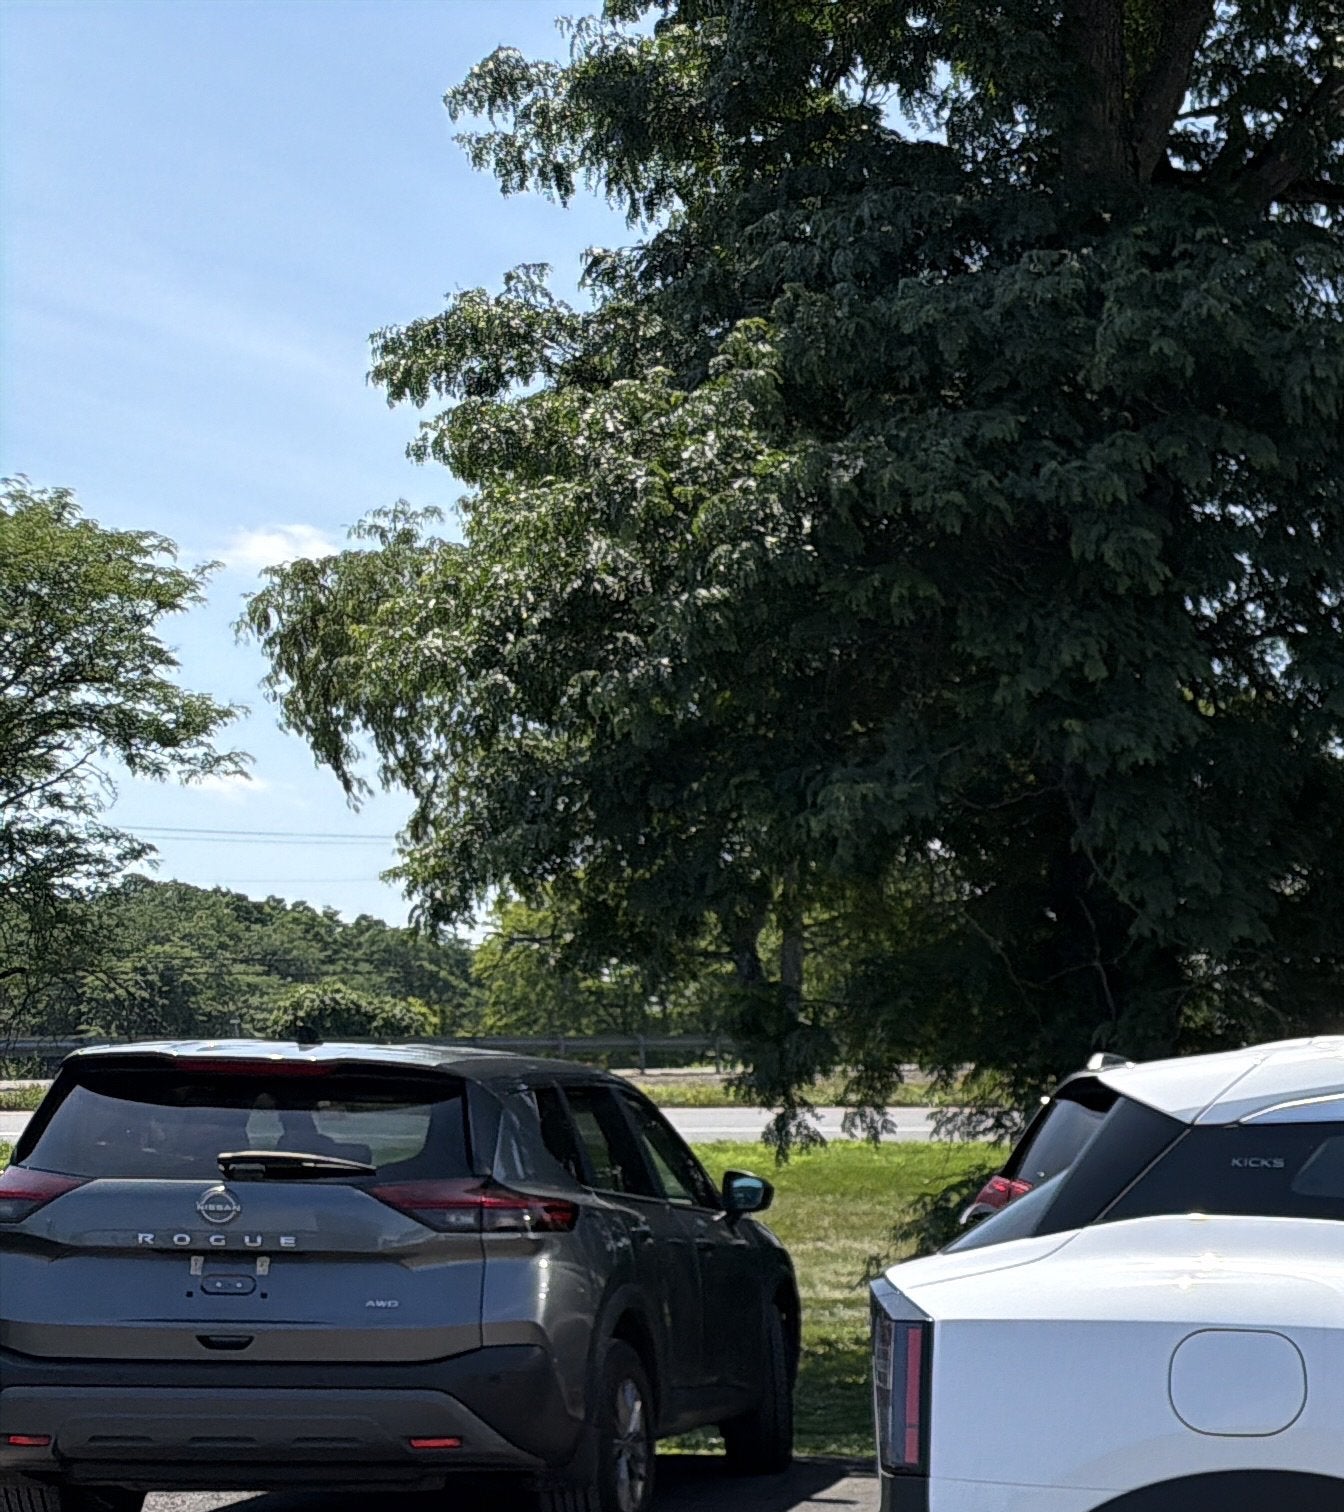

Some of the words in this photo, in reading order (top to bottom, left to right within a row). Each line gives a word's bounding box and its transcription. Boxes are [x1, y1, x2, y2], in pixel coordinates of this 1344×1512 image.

[1231, 1157, 1285, 1168] KICKS
[195, 1201, 241, 1212] NISSAN
[137, 1233, 297, 1248] ROGUE
[365, 1300, 399, 1308] AWD
